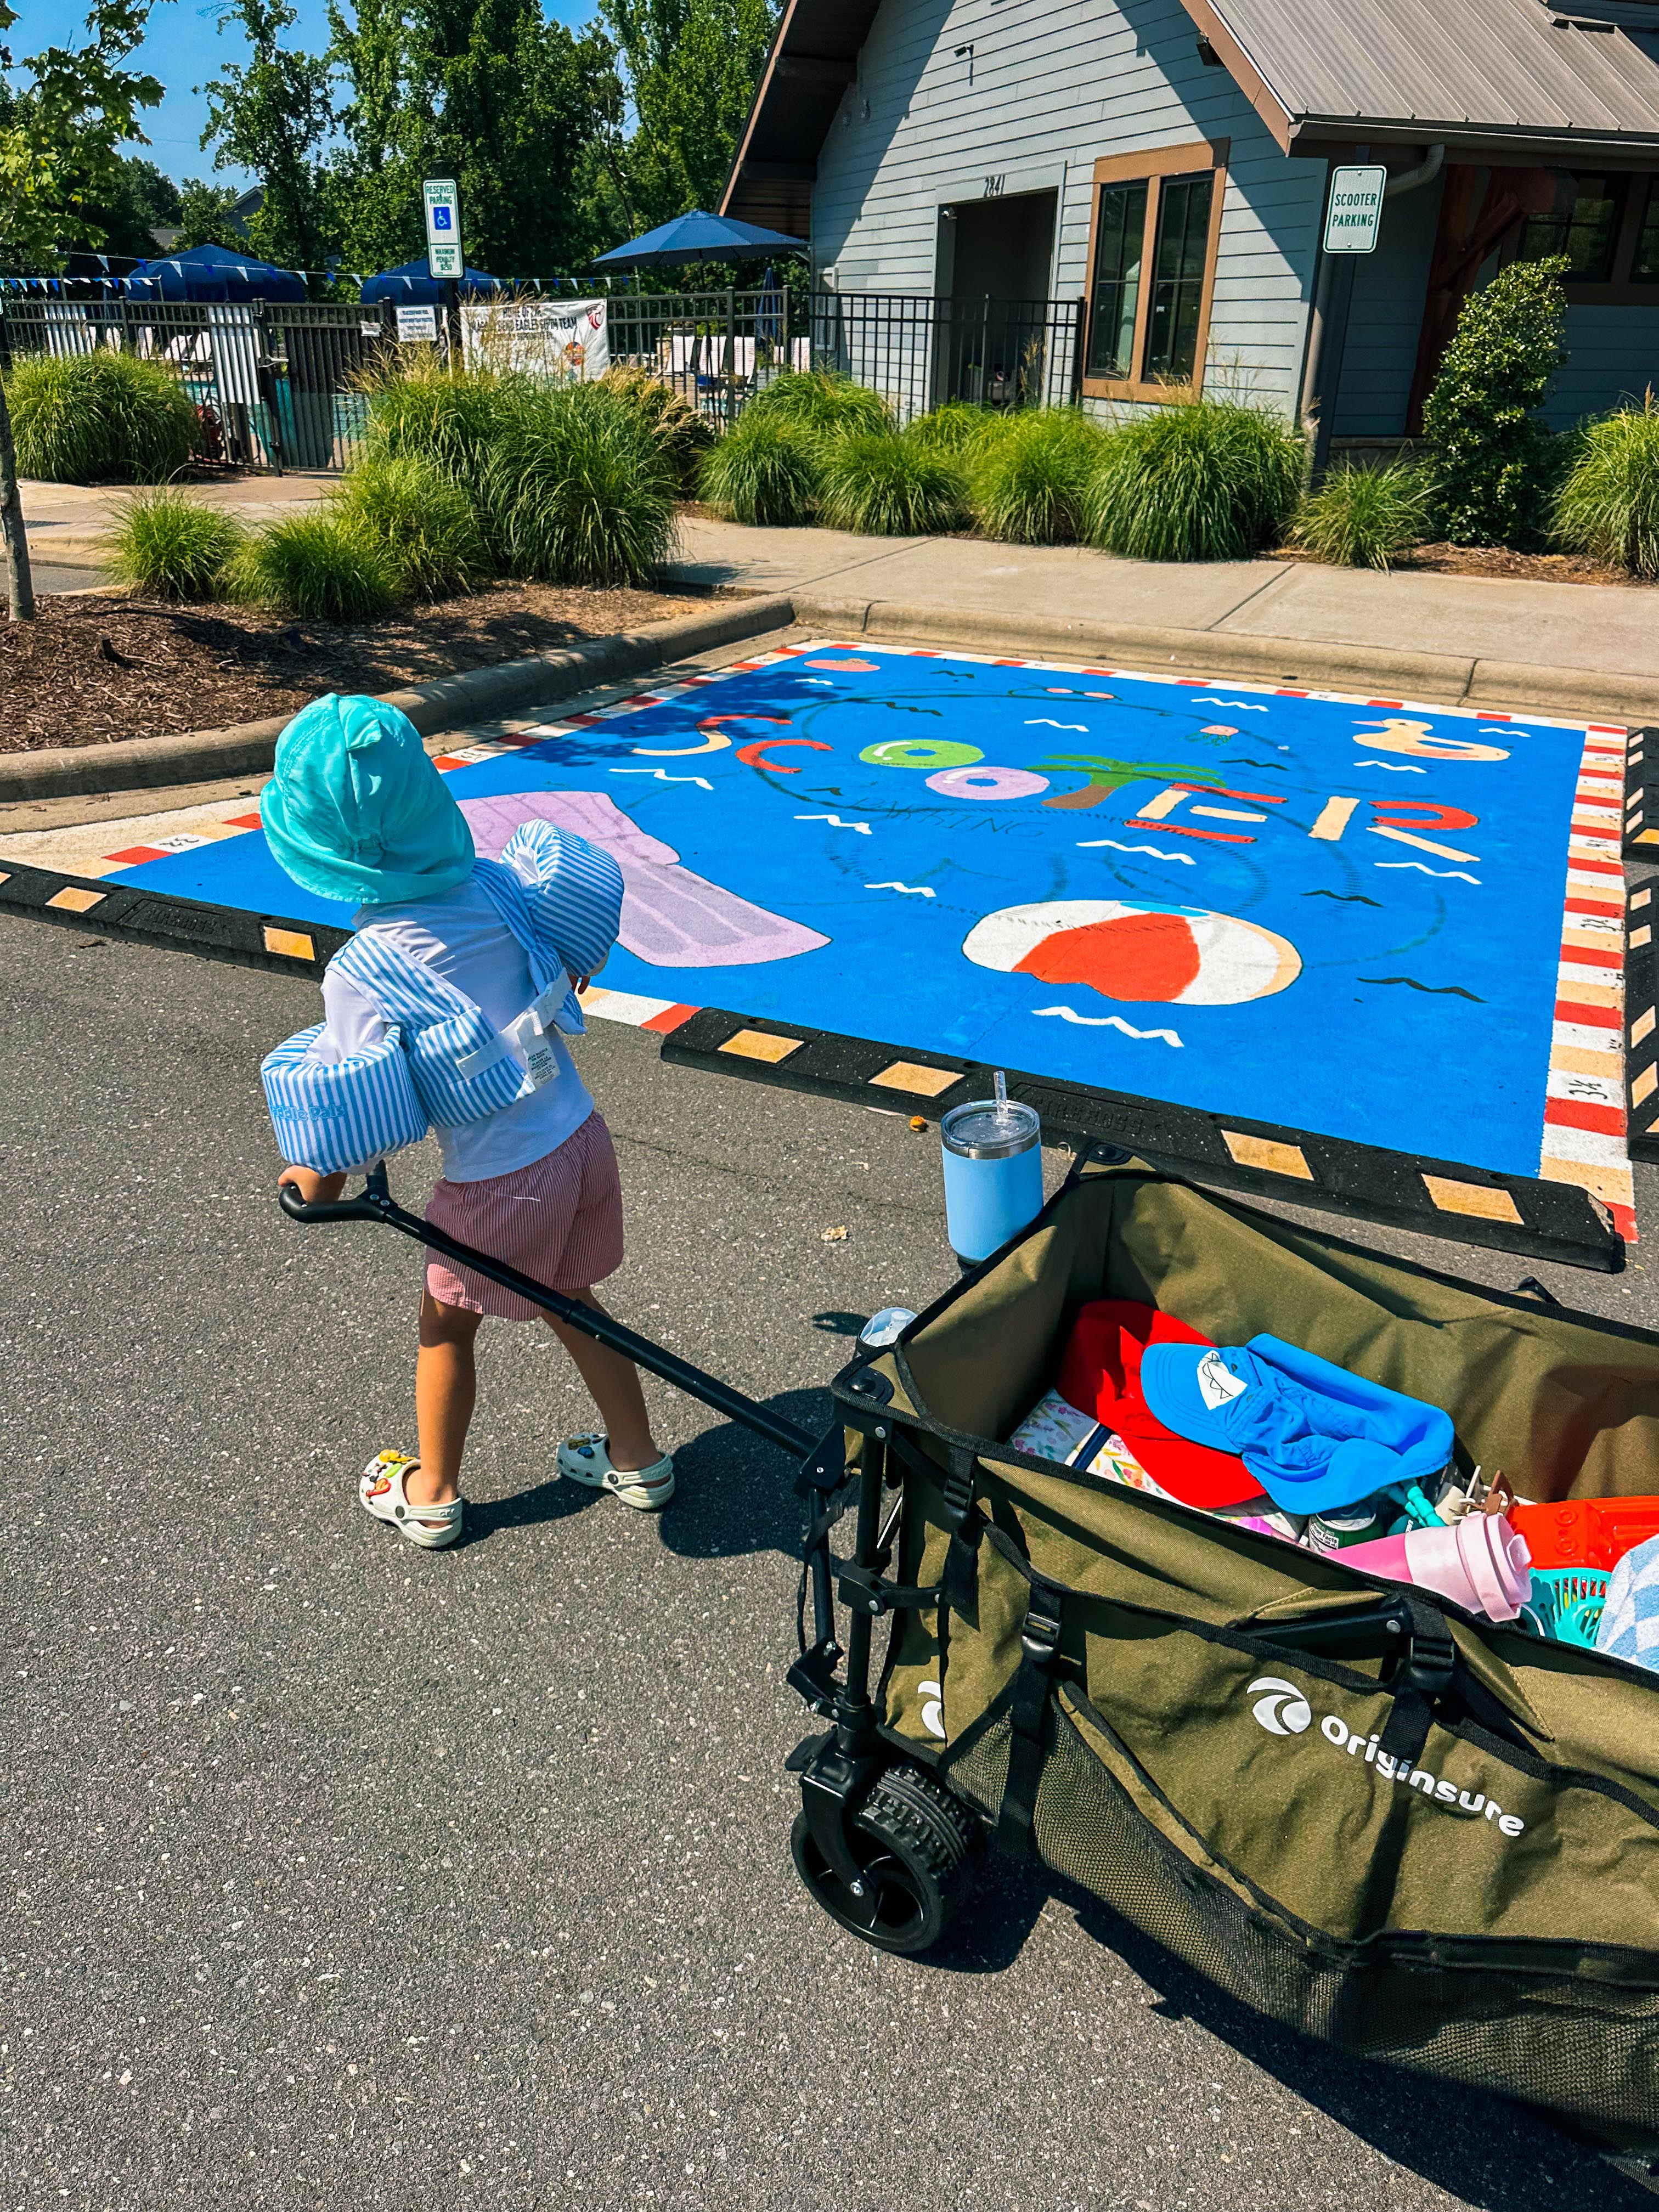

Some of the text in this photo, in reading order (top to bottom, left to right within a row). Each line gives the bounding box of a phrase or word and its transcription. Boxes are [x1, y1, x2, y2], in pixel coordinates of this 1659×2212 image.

[426, 185, 454, 194] RESERVED
[983, 175, 1006, 198] 2841
[430, 196, 453, 205] PARKING
[1335, 193, 1378, 206] SCOOTER
[1332, 213, 1374, 227] PARKING
[558, 316, 578, 330] TEAM
[308, 1103, 346, 1121] Pals
[1322, 1533, 1338, 1544] Facts
[1320, 1714, 1525, 1838] Originsure
